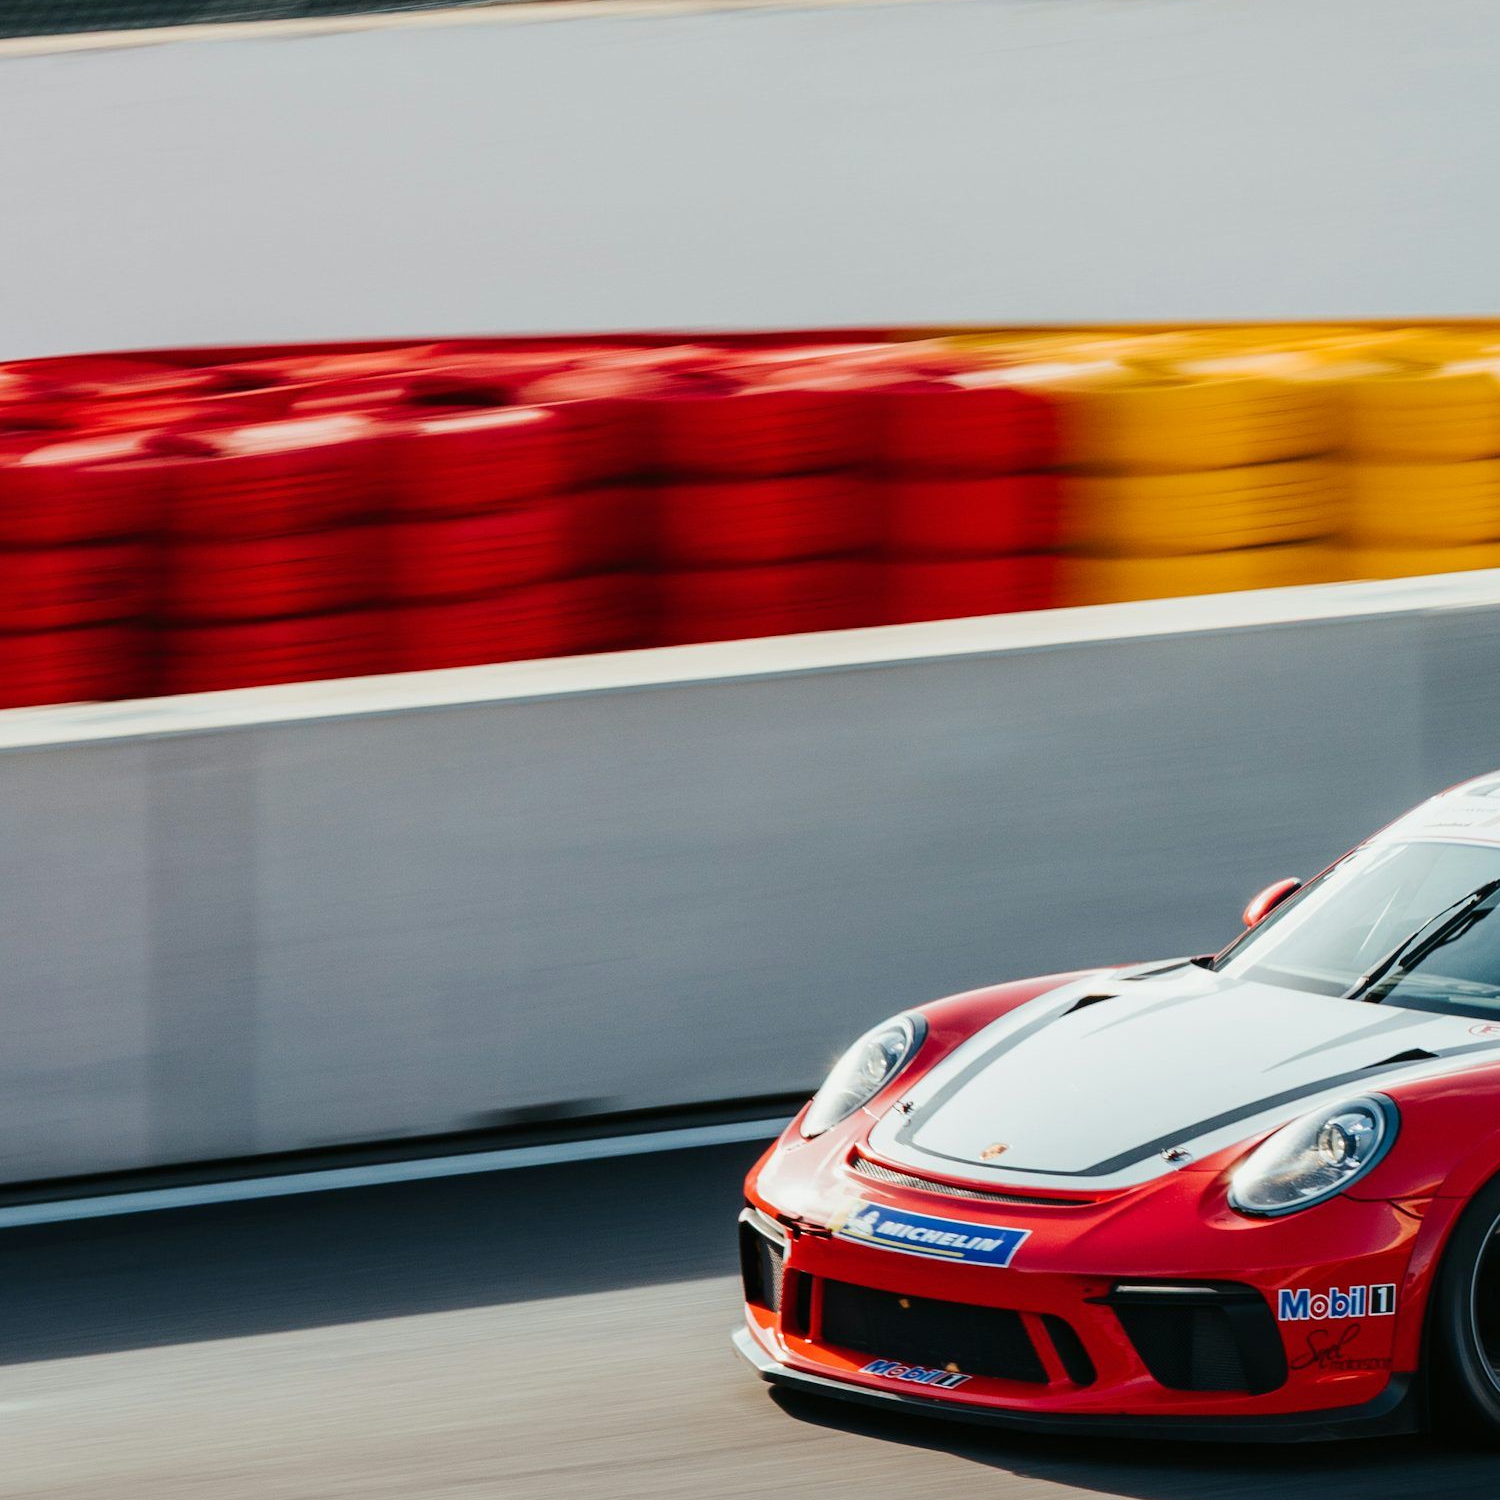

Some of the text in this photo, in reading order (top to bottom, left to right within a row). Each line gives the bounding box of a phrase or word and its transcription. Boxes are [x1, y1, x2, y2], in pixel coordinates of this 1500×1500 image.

[875, 1220, 1005, 1252] MICHELIN
[1279, 1286, 1367, 1320] Mobil
[859, 1359, 946, 1384] Mobil
